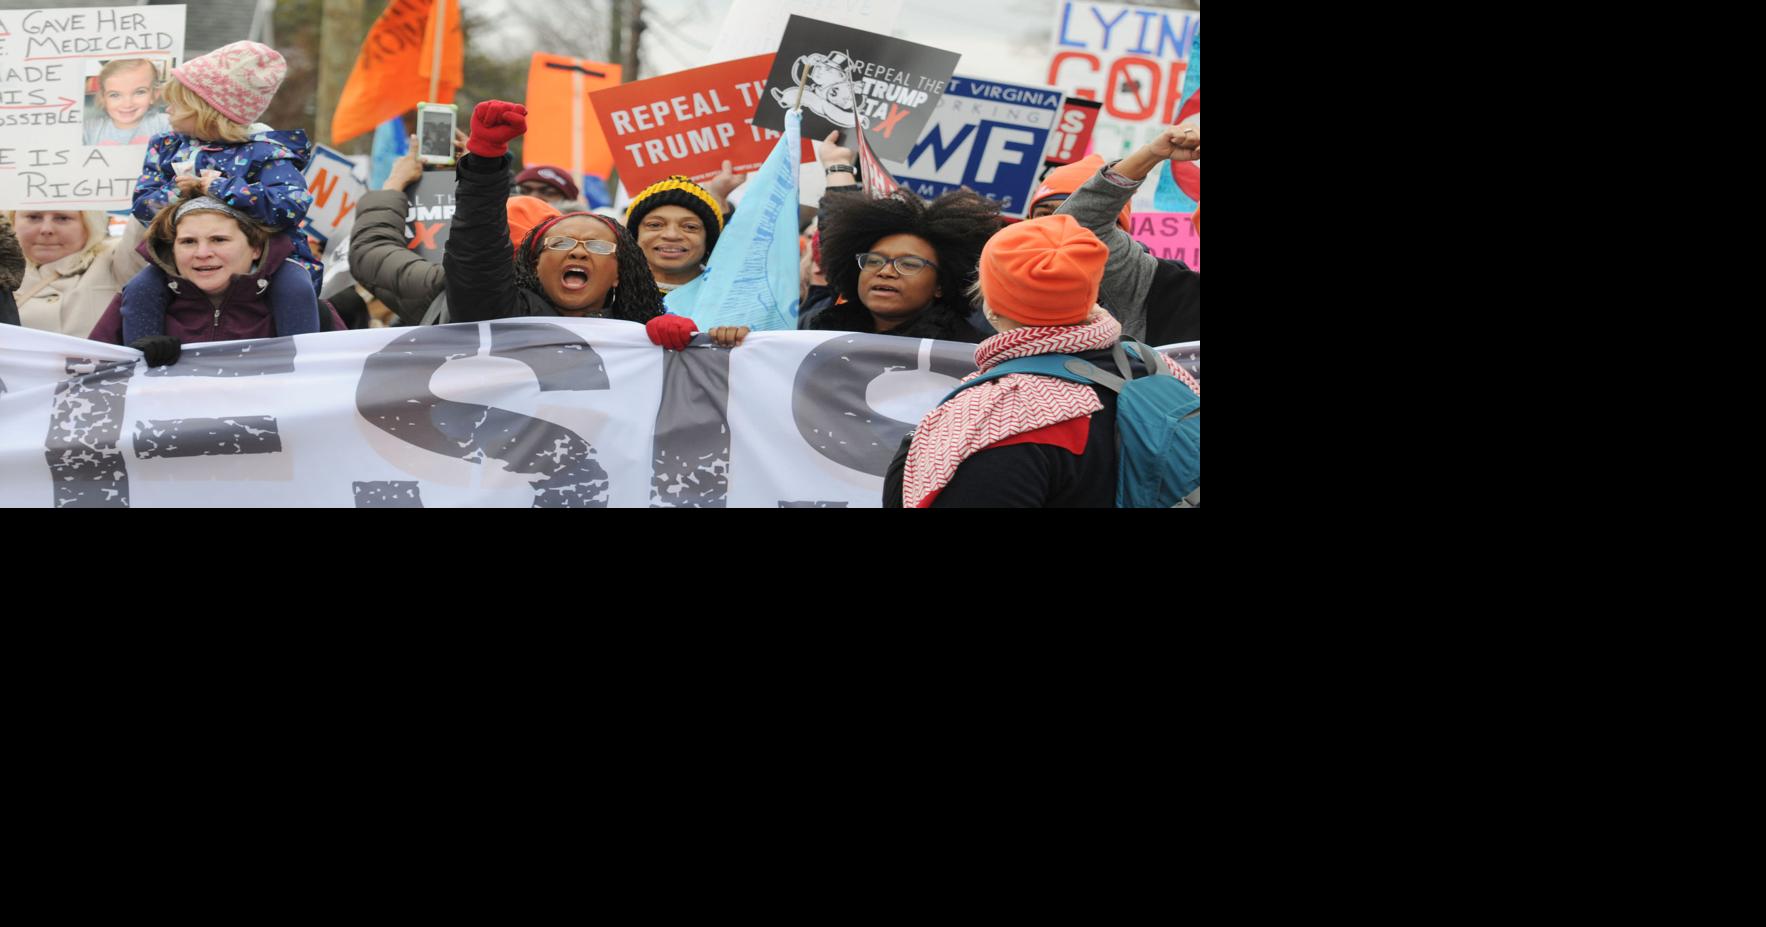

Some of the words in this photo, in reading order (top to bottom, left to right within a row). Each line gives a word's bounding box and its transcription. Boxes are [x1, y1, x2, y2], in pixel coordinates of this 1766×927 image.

[22, 10, 85, 34] GAVE
[97, 9, 147, 32] HER
[26, 32, 173, 58] MEDICAID
[0, 64, 63, 83] ADE
[853, 60, 912, 87] REPEAL
[912, 76, 945, 95] THE
[0, 89, 47, 105] IS
[861, 77, 928, 108] TRUMP
[971, 82, 1058, 108] VIRGINIA
[611, 89, 730, 136] REPEAL
[864, 96, 911, 139] TAX
[29, 149, 70, 167] IS
[83, 149, 109, 167] A
[625, 122, 735, 168] TRUMP
[18, 171, 138, 198] RIGHT
